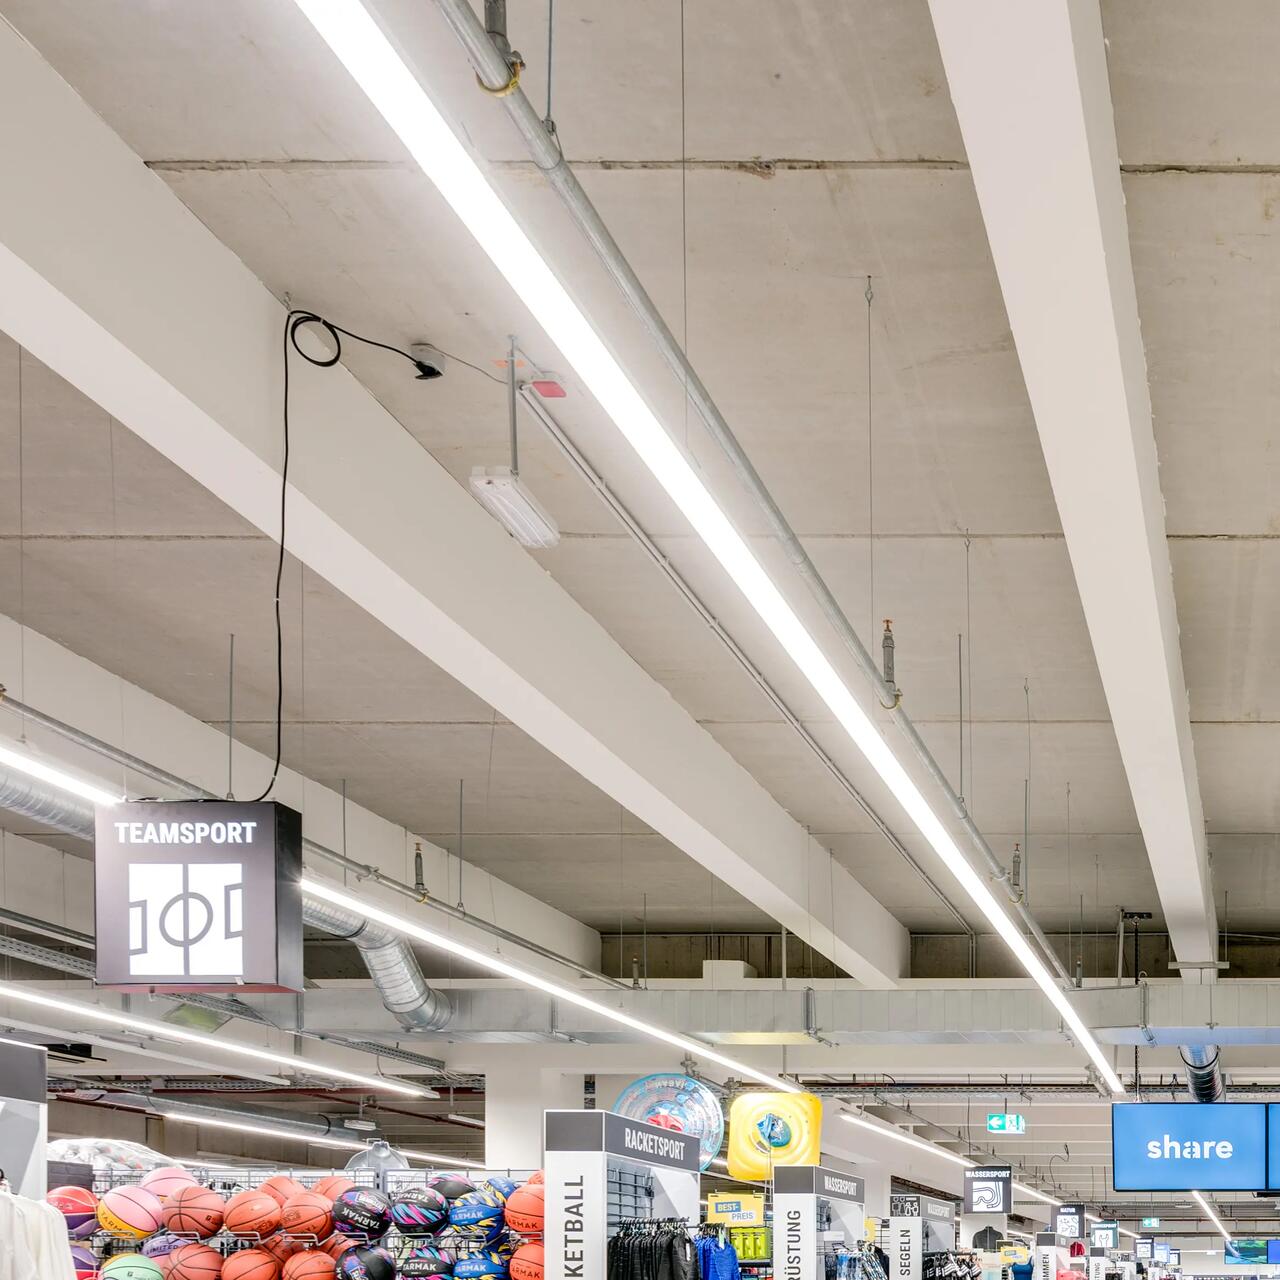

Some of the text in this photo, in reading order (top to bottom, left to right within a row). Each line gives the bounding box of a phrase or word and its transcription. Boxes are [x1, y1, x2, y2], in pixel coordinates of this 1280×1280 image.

[114, 821, 257, 844] TEAMSPORT
[624, 1127, 686, 1161] RACKETSPORT
[1147, 1134, 1233, 1159] share
[965, 1170, 1011, 1178] WASSERSPORT
[824, 1175, 857, 1196] WASSERSPORT
[342, 1207, 380, 1229] TARMAK
[731, 1212, 754, 1220] PREIS
[899, 1229, 911, 1276] SEGELN
[403, 1263, 437, 1271] TARMAK
